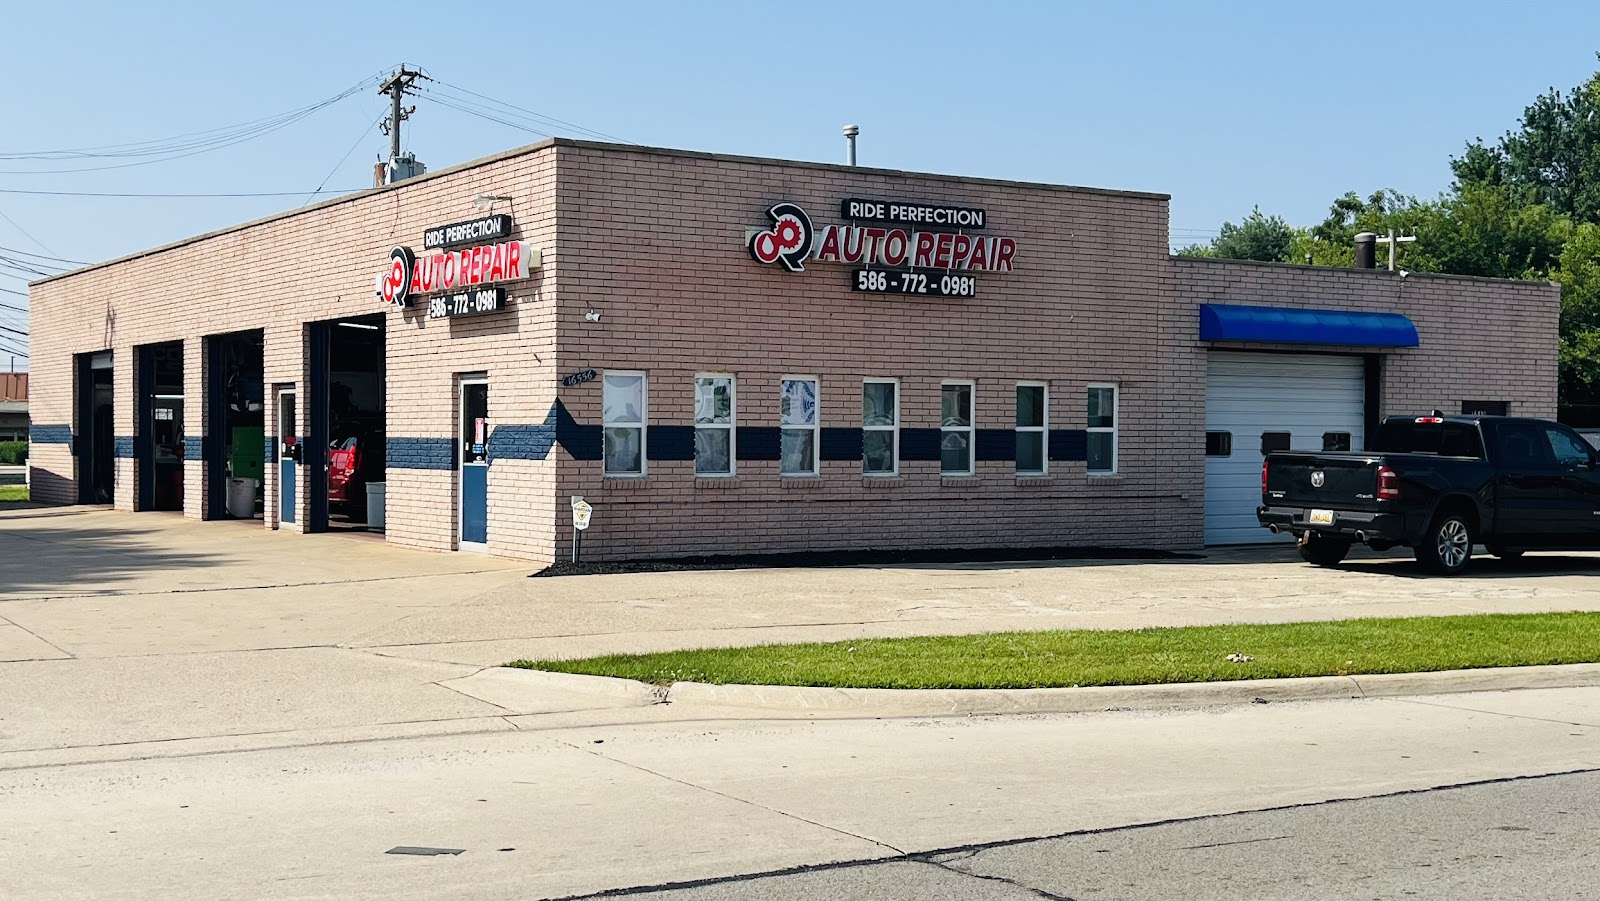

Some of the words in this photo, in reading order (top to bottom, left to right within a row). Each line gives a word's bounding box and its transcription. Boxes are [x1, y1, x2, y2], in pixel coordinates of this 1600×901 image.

[850, 202, 885, 219] RIDE
[890, 205, 983, 226] PERFECTION
[425, 230, 445, 247] RIDE
[446, 217, 501, 243] PERFECTION
[816, 225, 908, 265] AUTO
[912, 231, 1017, 272] REPAIR
[409, 252, 456, 294] AUTO
[459, 241, 521, 287] REPAIR
[568, 370, 593, 385] 16556
